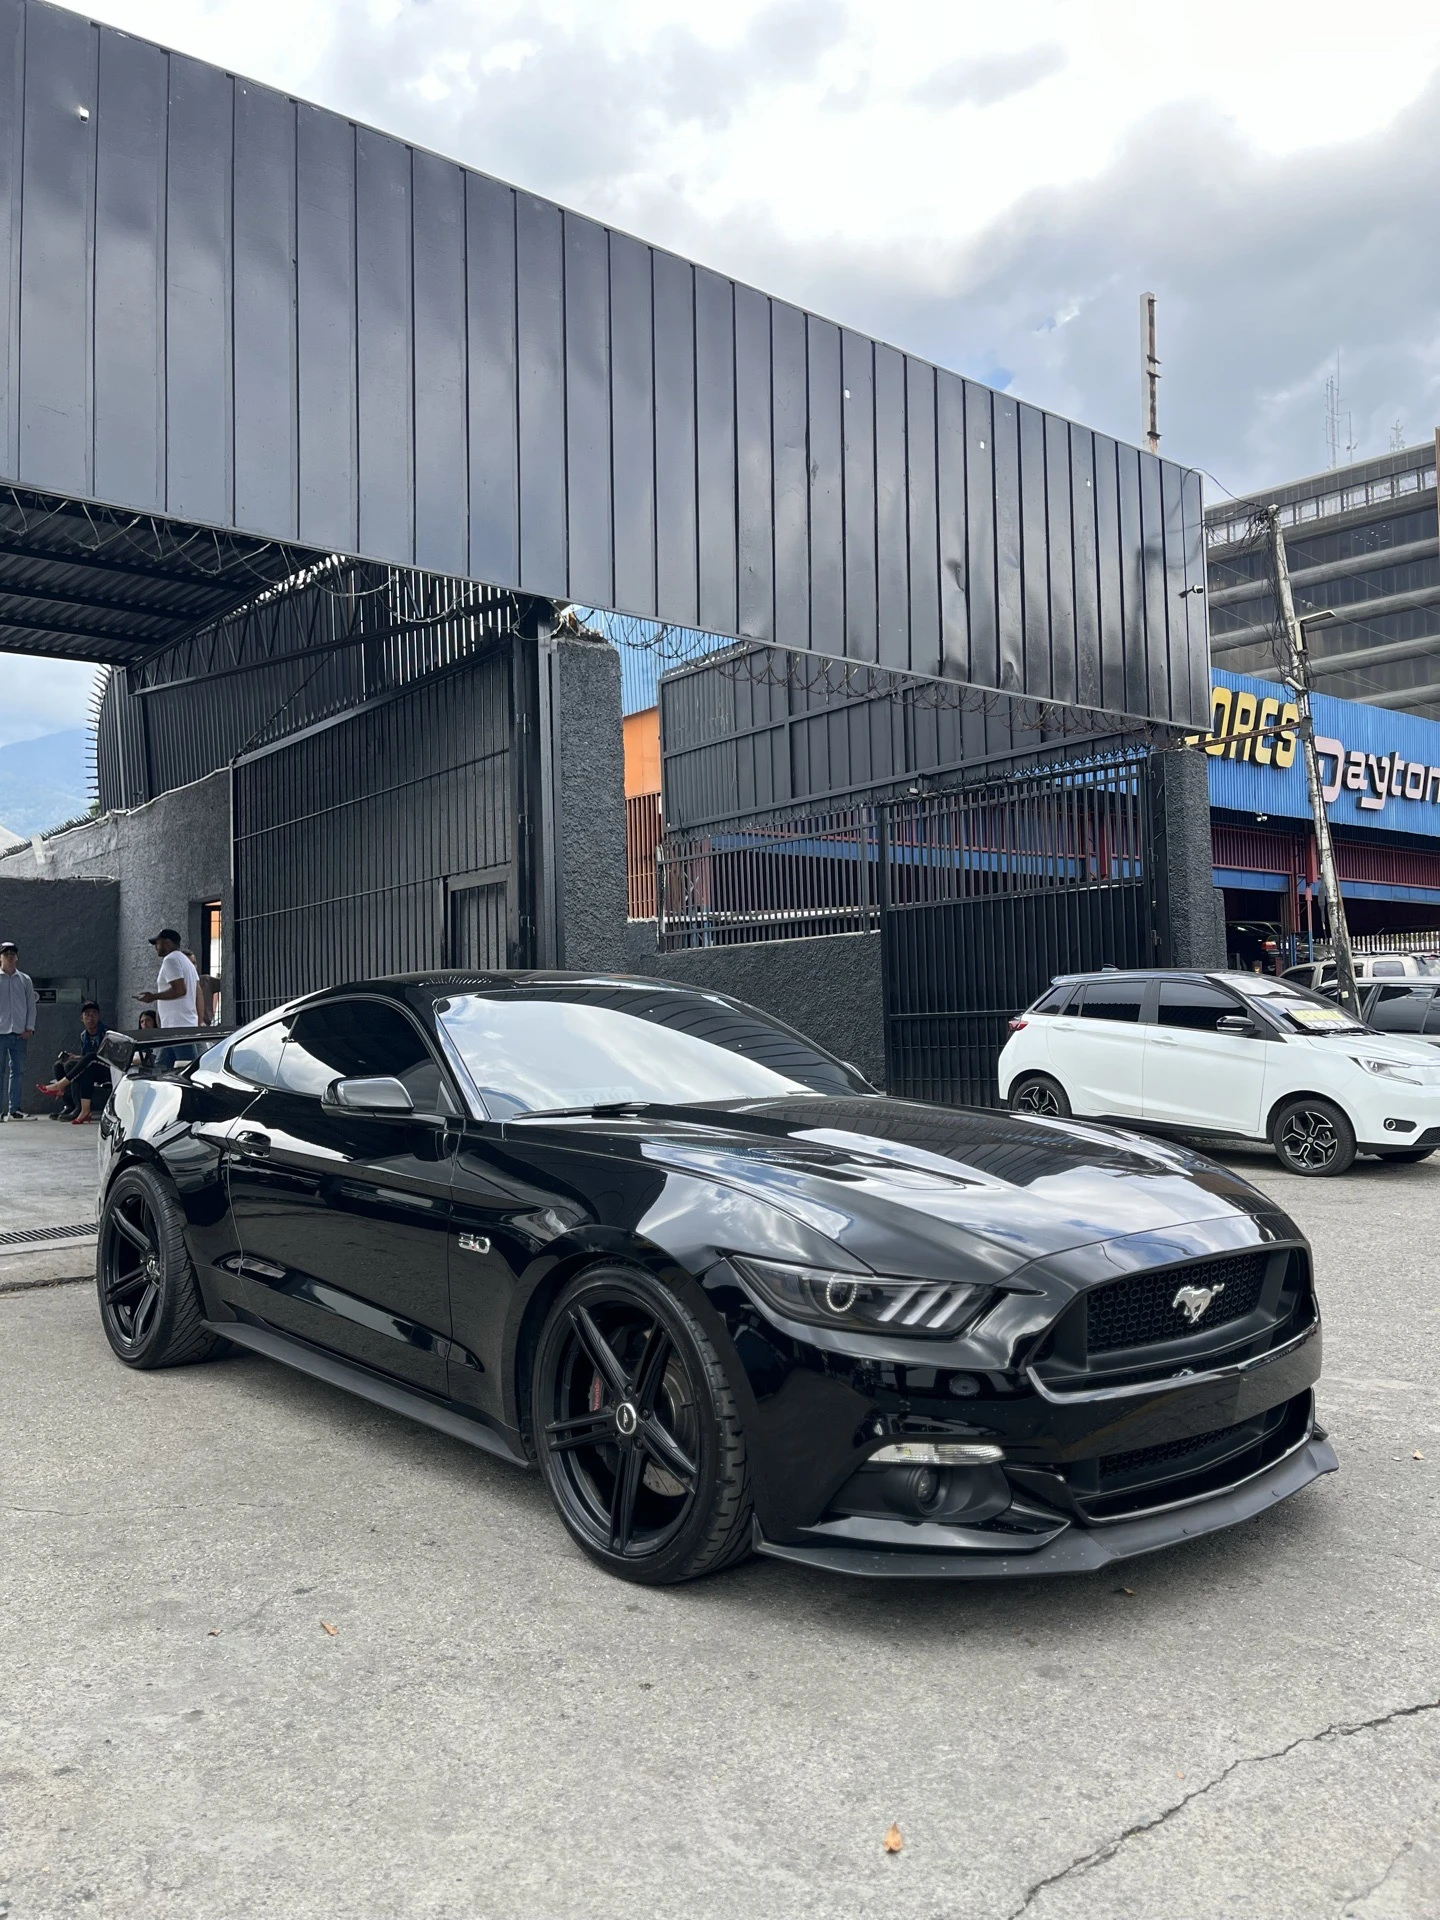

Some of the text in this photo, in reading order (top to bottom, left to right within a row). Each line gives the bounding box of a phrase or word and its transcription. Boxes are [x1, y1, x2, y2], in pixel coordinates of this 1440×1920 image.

[1185, 687, 1299, 768] ORES
[1313, 735, 1440, 810] Dayton
[458, 1232, 491, 1254] 5.0
